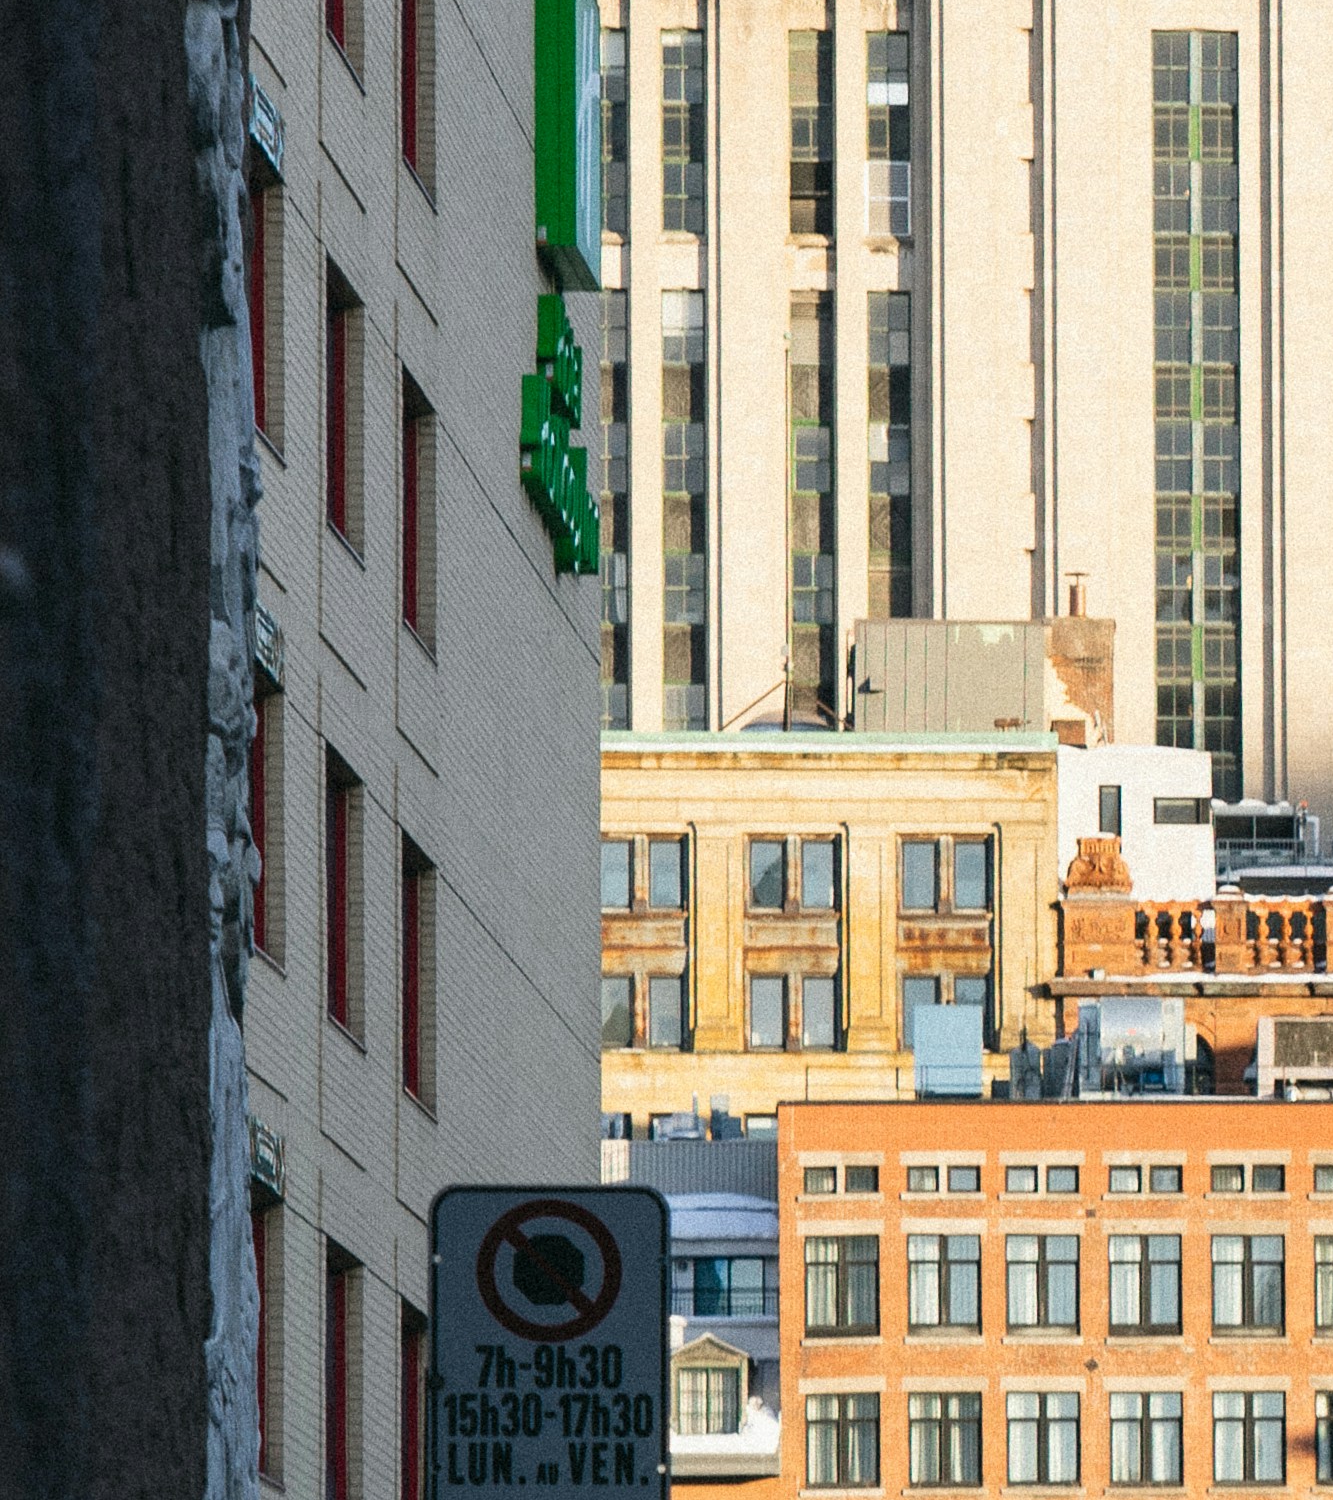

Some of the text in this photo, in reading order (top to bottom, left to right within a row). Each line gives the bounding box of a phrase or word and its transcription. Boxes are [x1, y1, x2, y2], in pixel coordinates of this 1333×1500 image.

[475, 1344, 623, 1389] 7h-9h30
[443, 1393, 654, 1438] 15h30-17h30
[447, 1442, 649, 1486] LUN. AU VEN.
